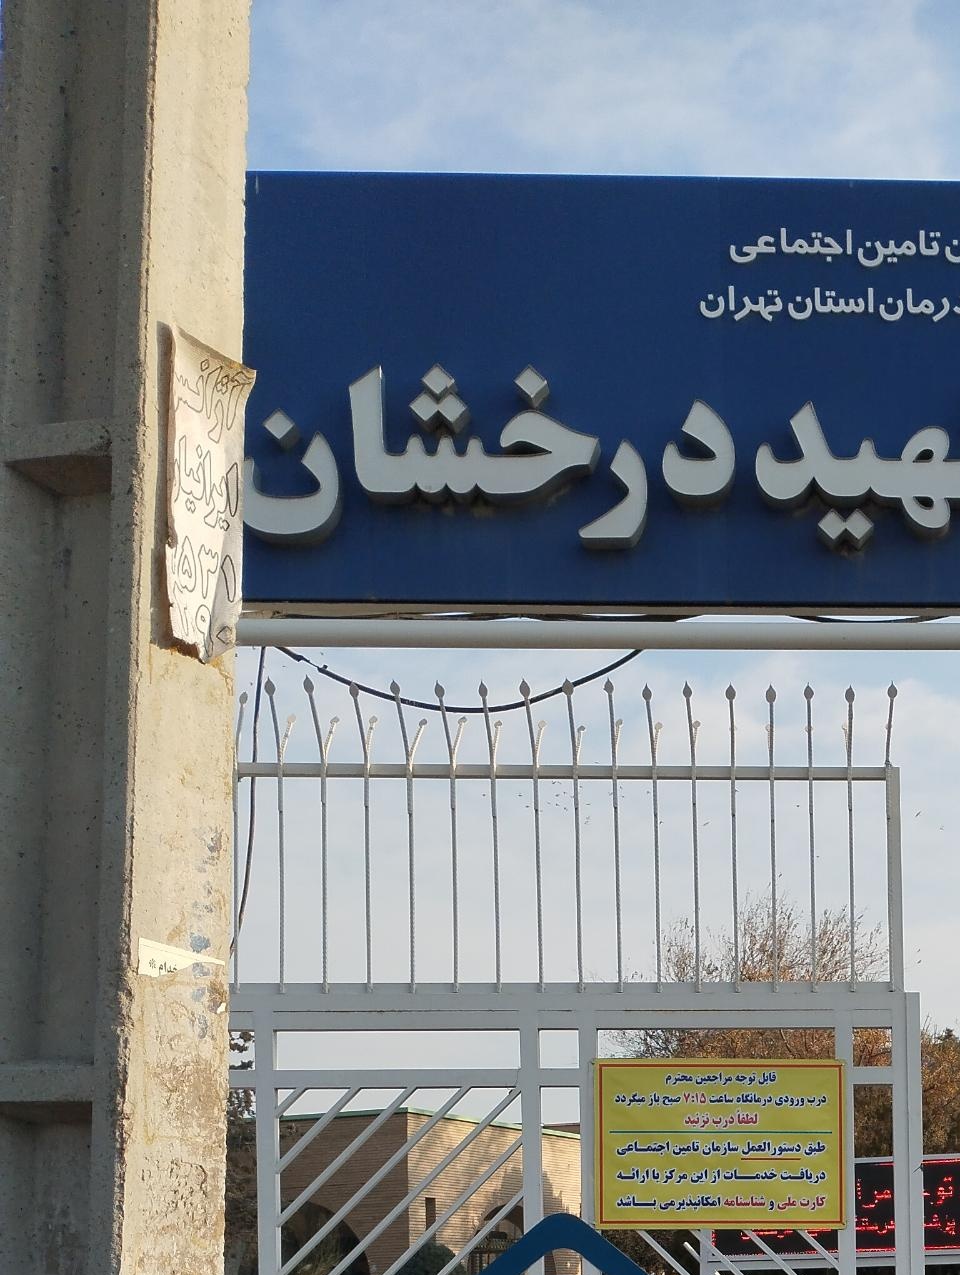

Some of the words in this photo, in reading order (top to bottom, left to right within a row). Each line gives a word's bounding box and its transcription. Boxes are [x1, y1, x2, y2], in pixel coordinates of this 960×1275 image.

[729, 227, 853, 263] اجتماعی
[857, 229, 941, 267] تامین
[700, 285, 783, 322] تهران
[788, 287, 874, 320] استان
[244, 363, 737, 550] درخشان
[665, 1073, 693, 1085] محترم
[695, 1072, 733, 1085] مراجعین
[735, 1074, 757, 1086] توجه
[758, 1071, 777, 1084] قابل
[614, 1092, 646, 1105] میگردد
[648, 1094, 660, 1107] باز
[663, 1095, 682, 1106] صبح
[683, 1092, 707, 1104] ۷:۱۵
[709, 1094, 734, 1104] ساعت
[736, 1093, 773, 1107] درمانگاه
[775, 1094, 805, 1107] ورودی
[807, 1093, 827, 1107] درب
[684, 1114, 710, 1129] نزنید
[712, 1115, 735, 1128] درب
[616, 1141, 670, 1156] اجتماعی
[672, 1141, 700, 1156] تامین
[702, 1142, 739, 1156] سازمان
[804, 1141, 826, 1156] طبق
[616, 1167, 650, 1183] ارائه
[652, 1168, 661, 1181] با
[662, 1169, 688, 1183] مرکز
[690, 1168, 709, 1181] این
[712, 1168, 721, 1182] از
[723, 1167, 778, 1180] خدمات
[780, 1168, 826, 1183] دریافت
[616, 1195, 656, 1210] باشد
[723, 1196, 767, 1208] شناسنامه
[769, 1200, 775, 1211] و
[777, 1197, 797, 1211] ملی
[799, 1196, 826, 1210] کارت
